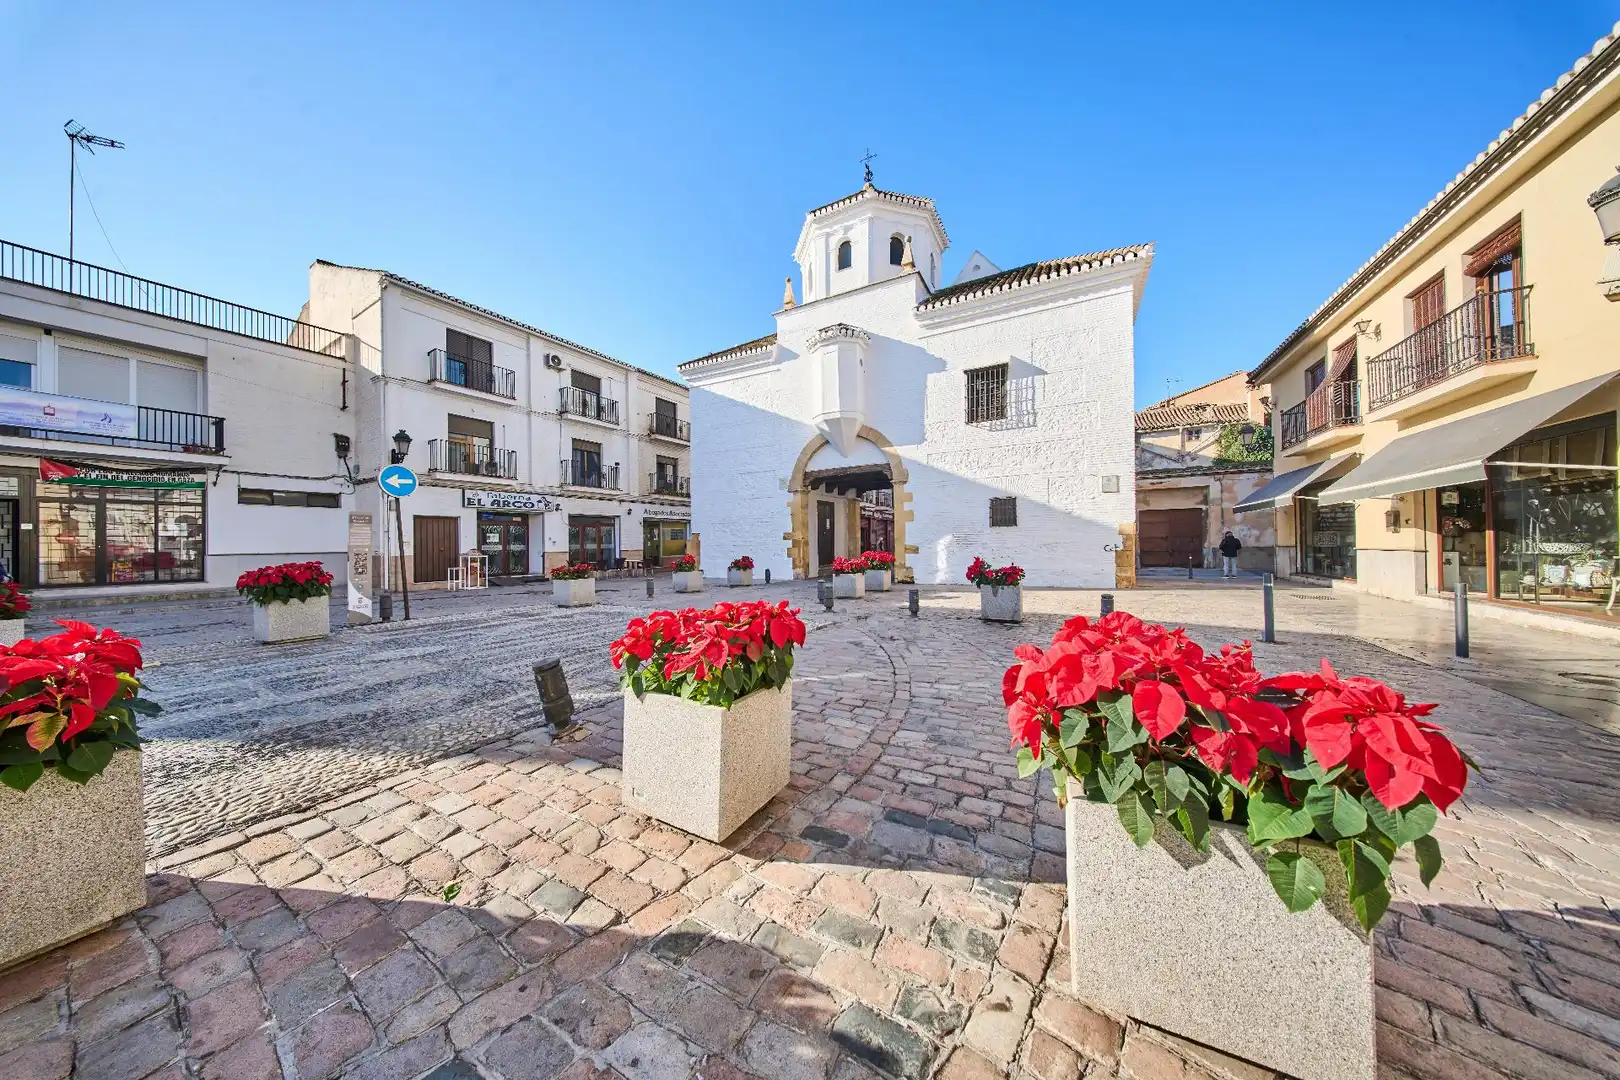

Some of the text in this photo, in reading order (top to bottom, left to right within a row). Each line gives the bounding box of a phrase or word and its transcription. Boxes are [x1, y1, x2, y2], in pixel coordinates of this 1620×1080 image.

[487, 492, 531, 501] Taberna
[466, 497, 535, 508] EL ARCO
